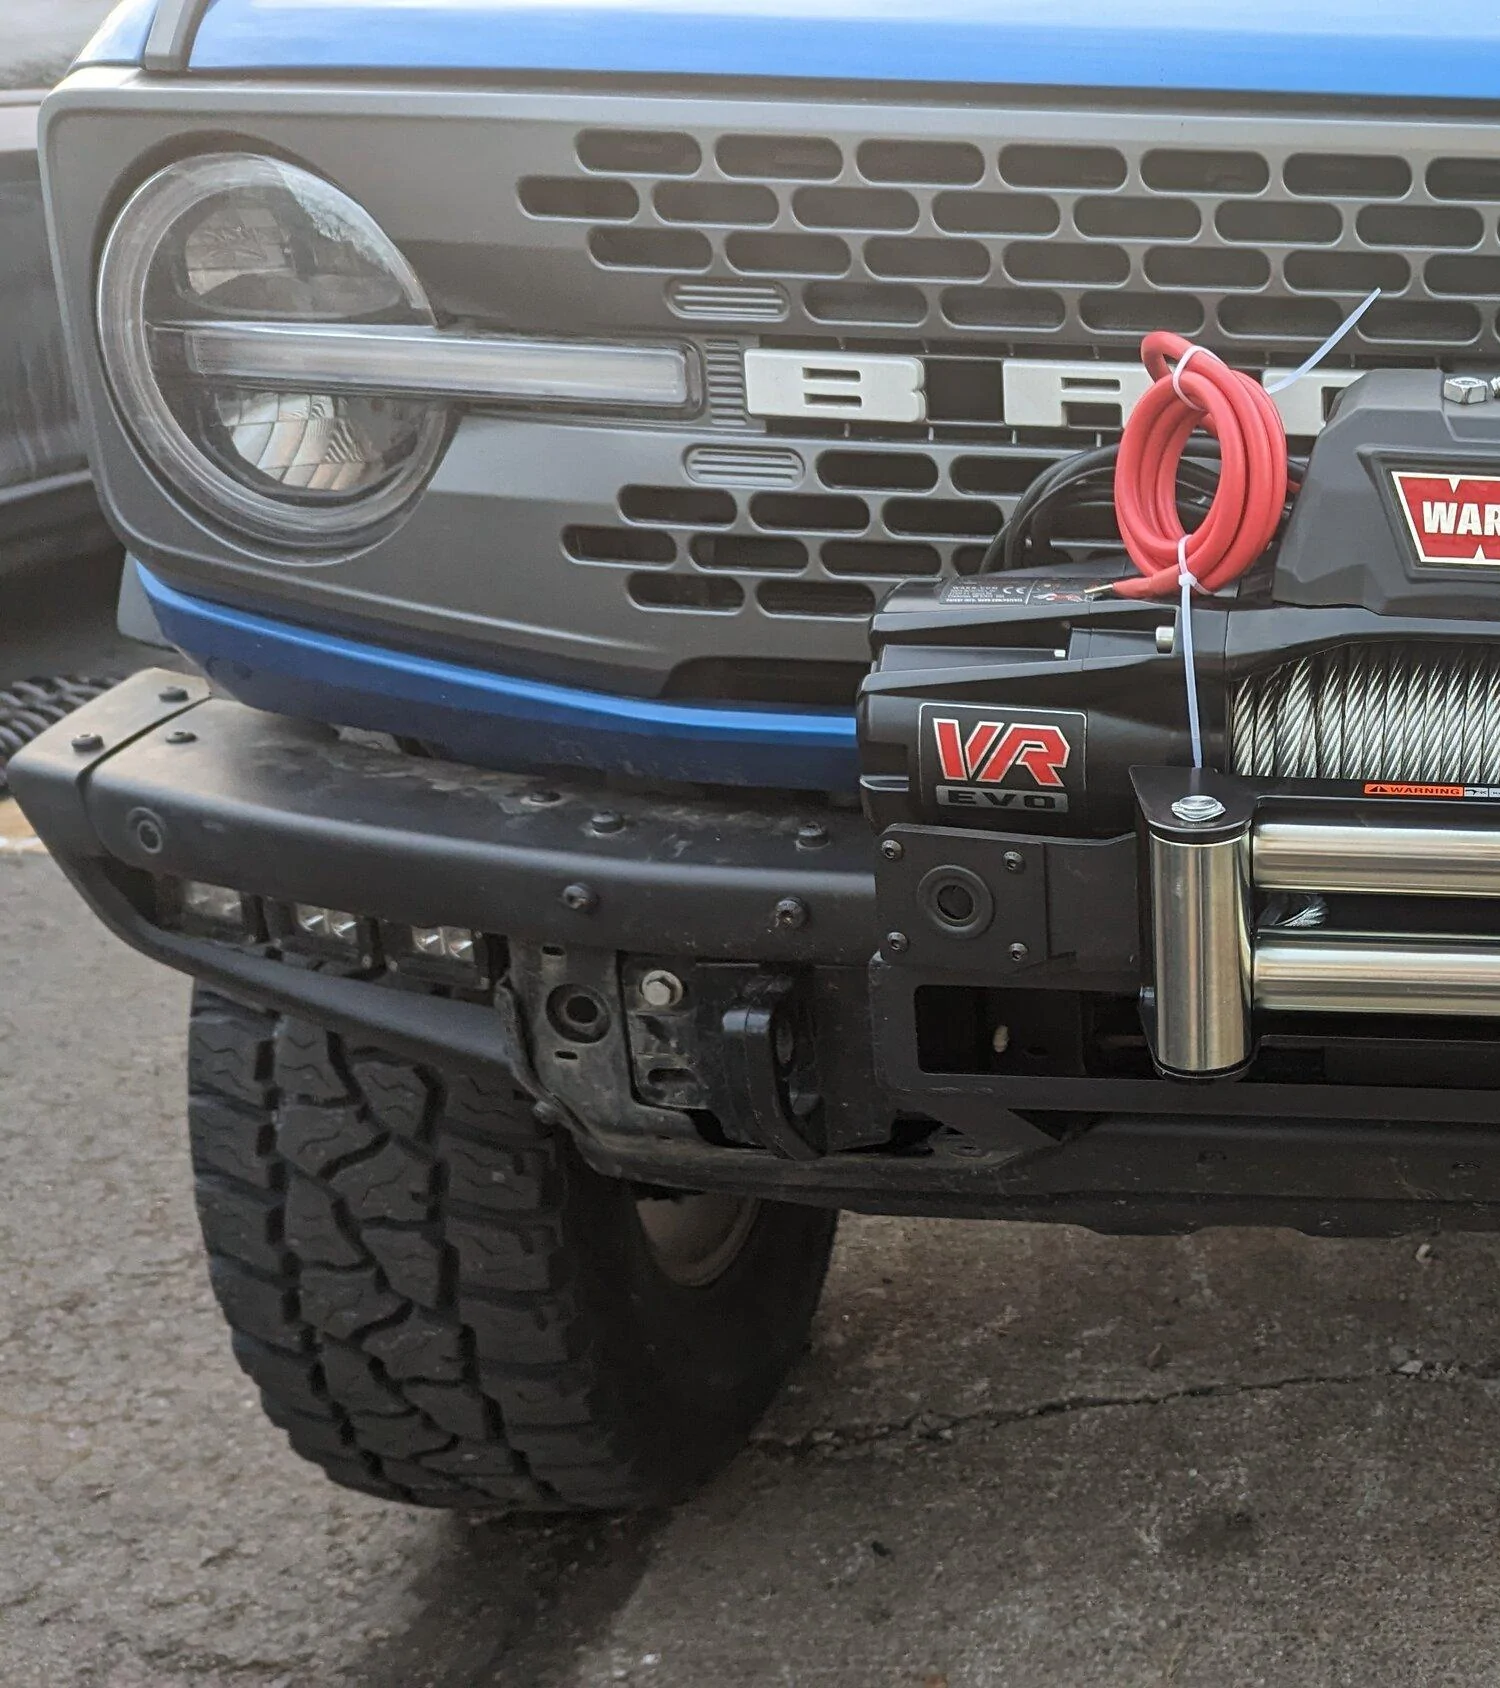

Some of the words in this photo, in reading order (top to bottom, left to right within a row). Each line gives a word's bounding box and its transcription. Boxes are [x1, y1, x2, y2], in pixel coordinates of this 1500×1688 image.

[933, 718, 1071, 787] VR
[948, 790, 1056, 809] EVO
[1391, 787, 1460, 795] WARNING
